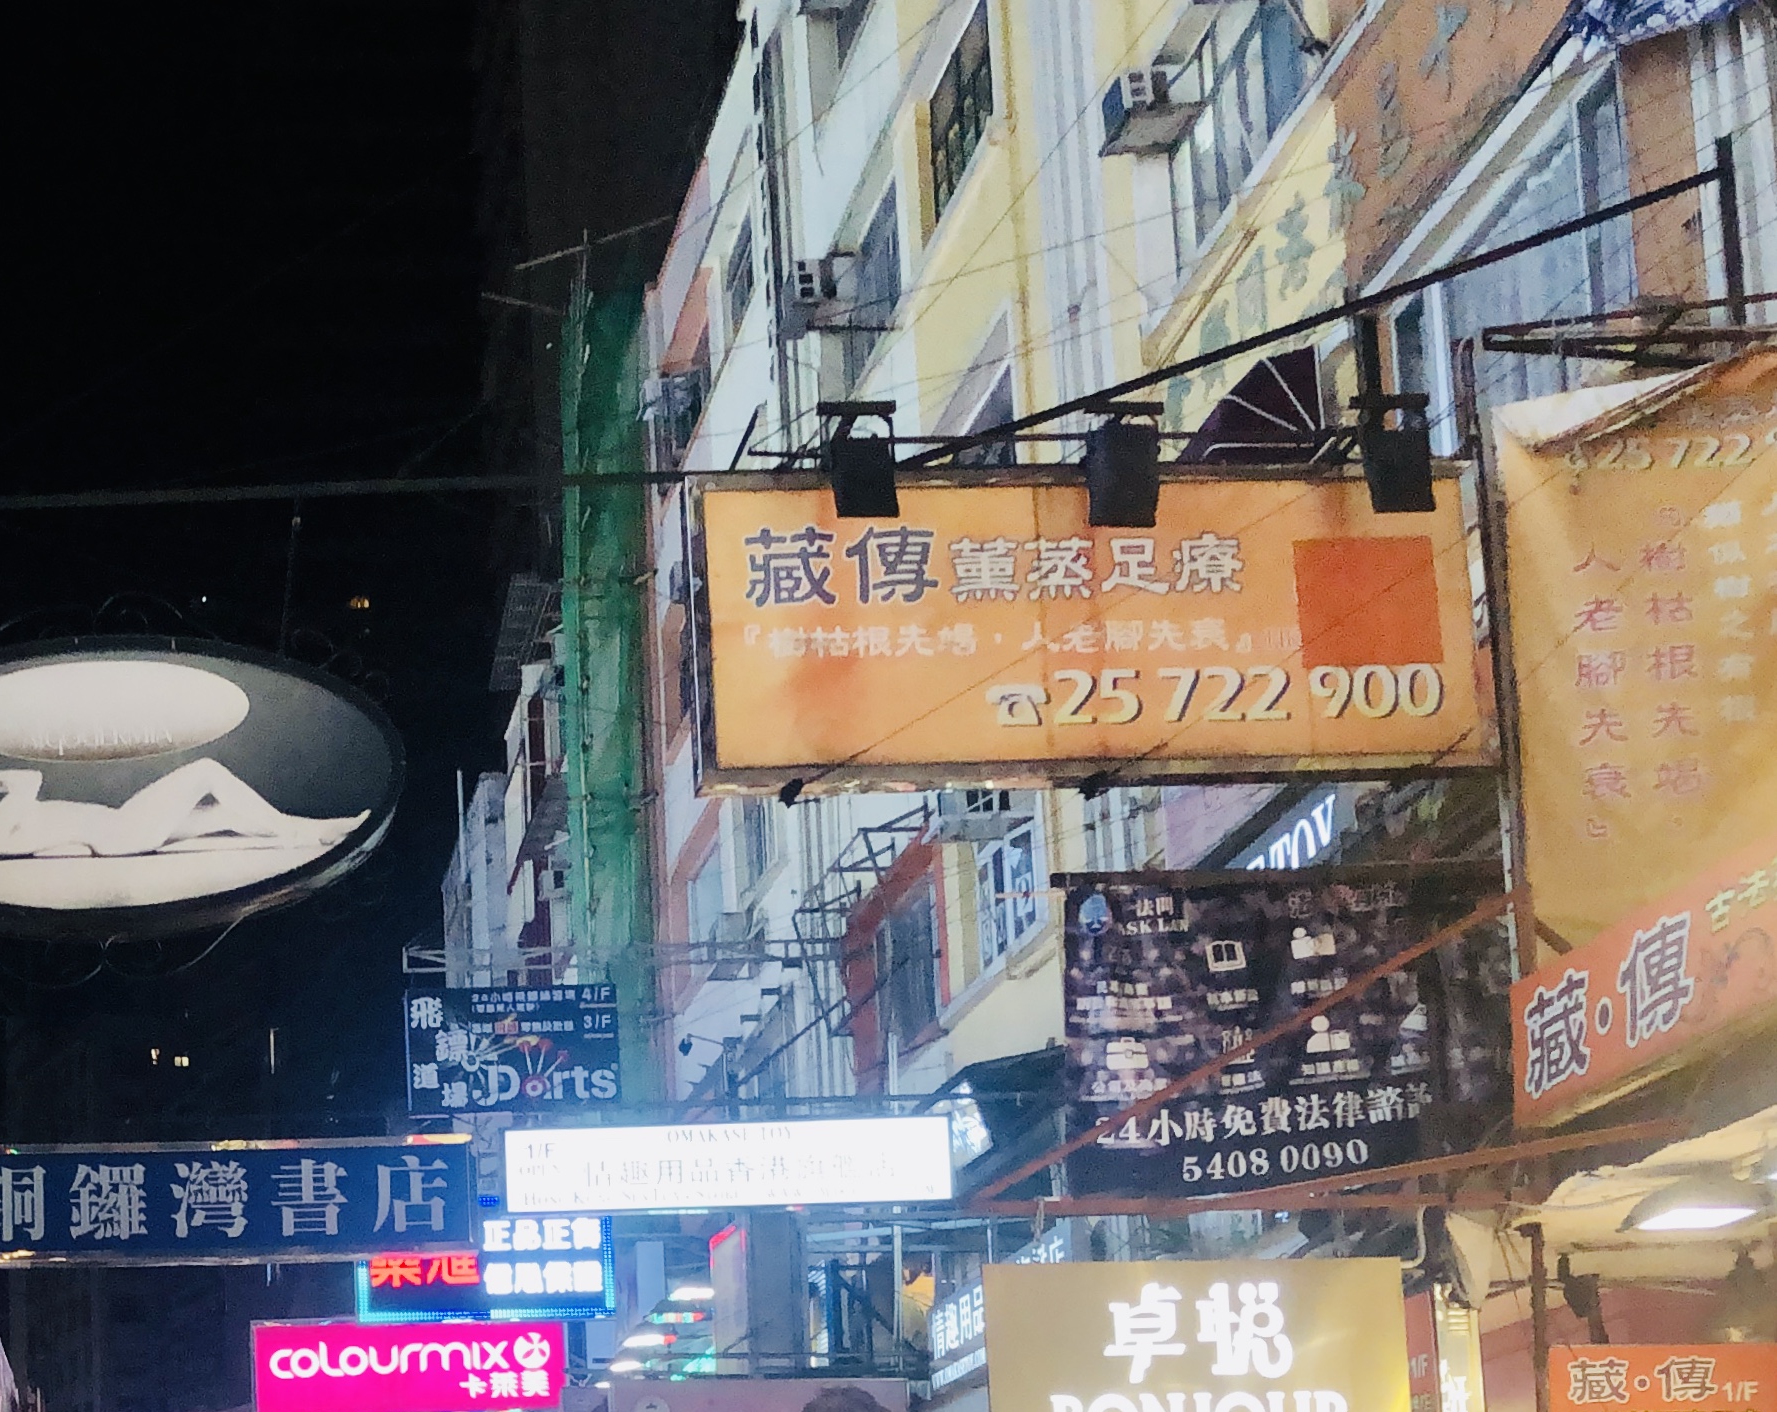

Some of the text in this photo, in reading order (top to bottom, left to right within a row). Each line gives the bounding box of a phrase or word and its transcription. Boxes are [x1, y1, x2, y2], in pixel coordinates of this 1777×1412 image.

[1666, 432, 1757, 469] 722
[1053, 664, 1445, 725] 25 722 900
[581, 986, 611, 1001] 4/F
[583, 1014, 612, 1030] 3/F
[1181, 1138, 1369, 1183] 5408 0090
